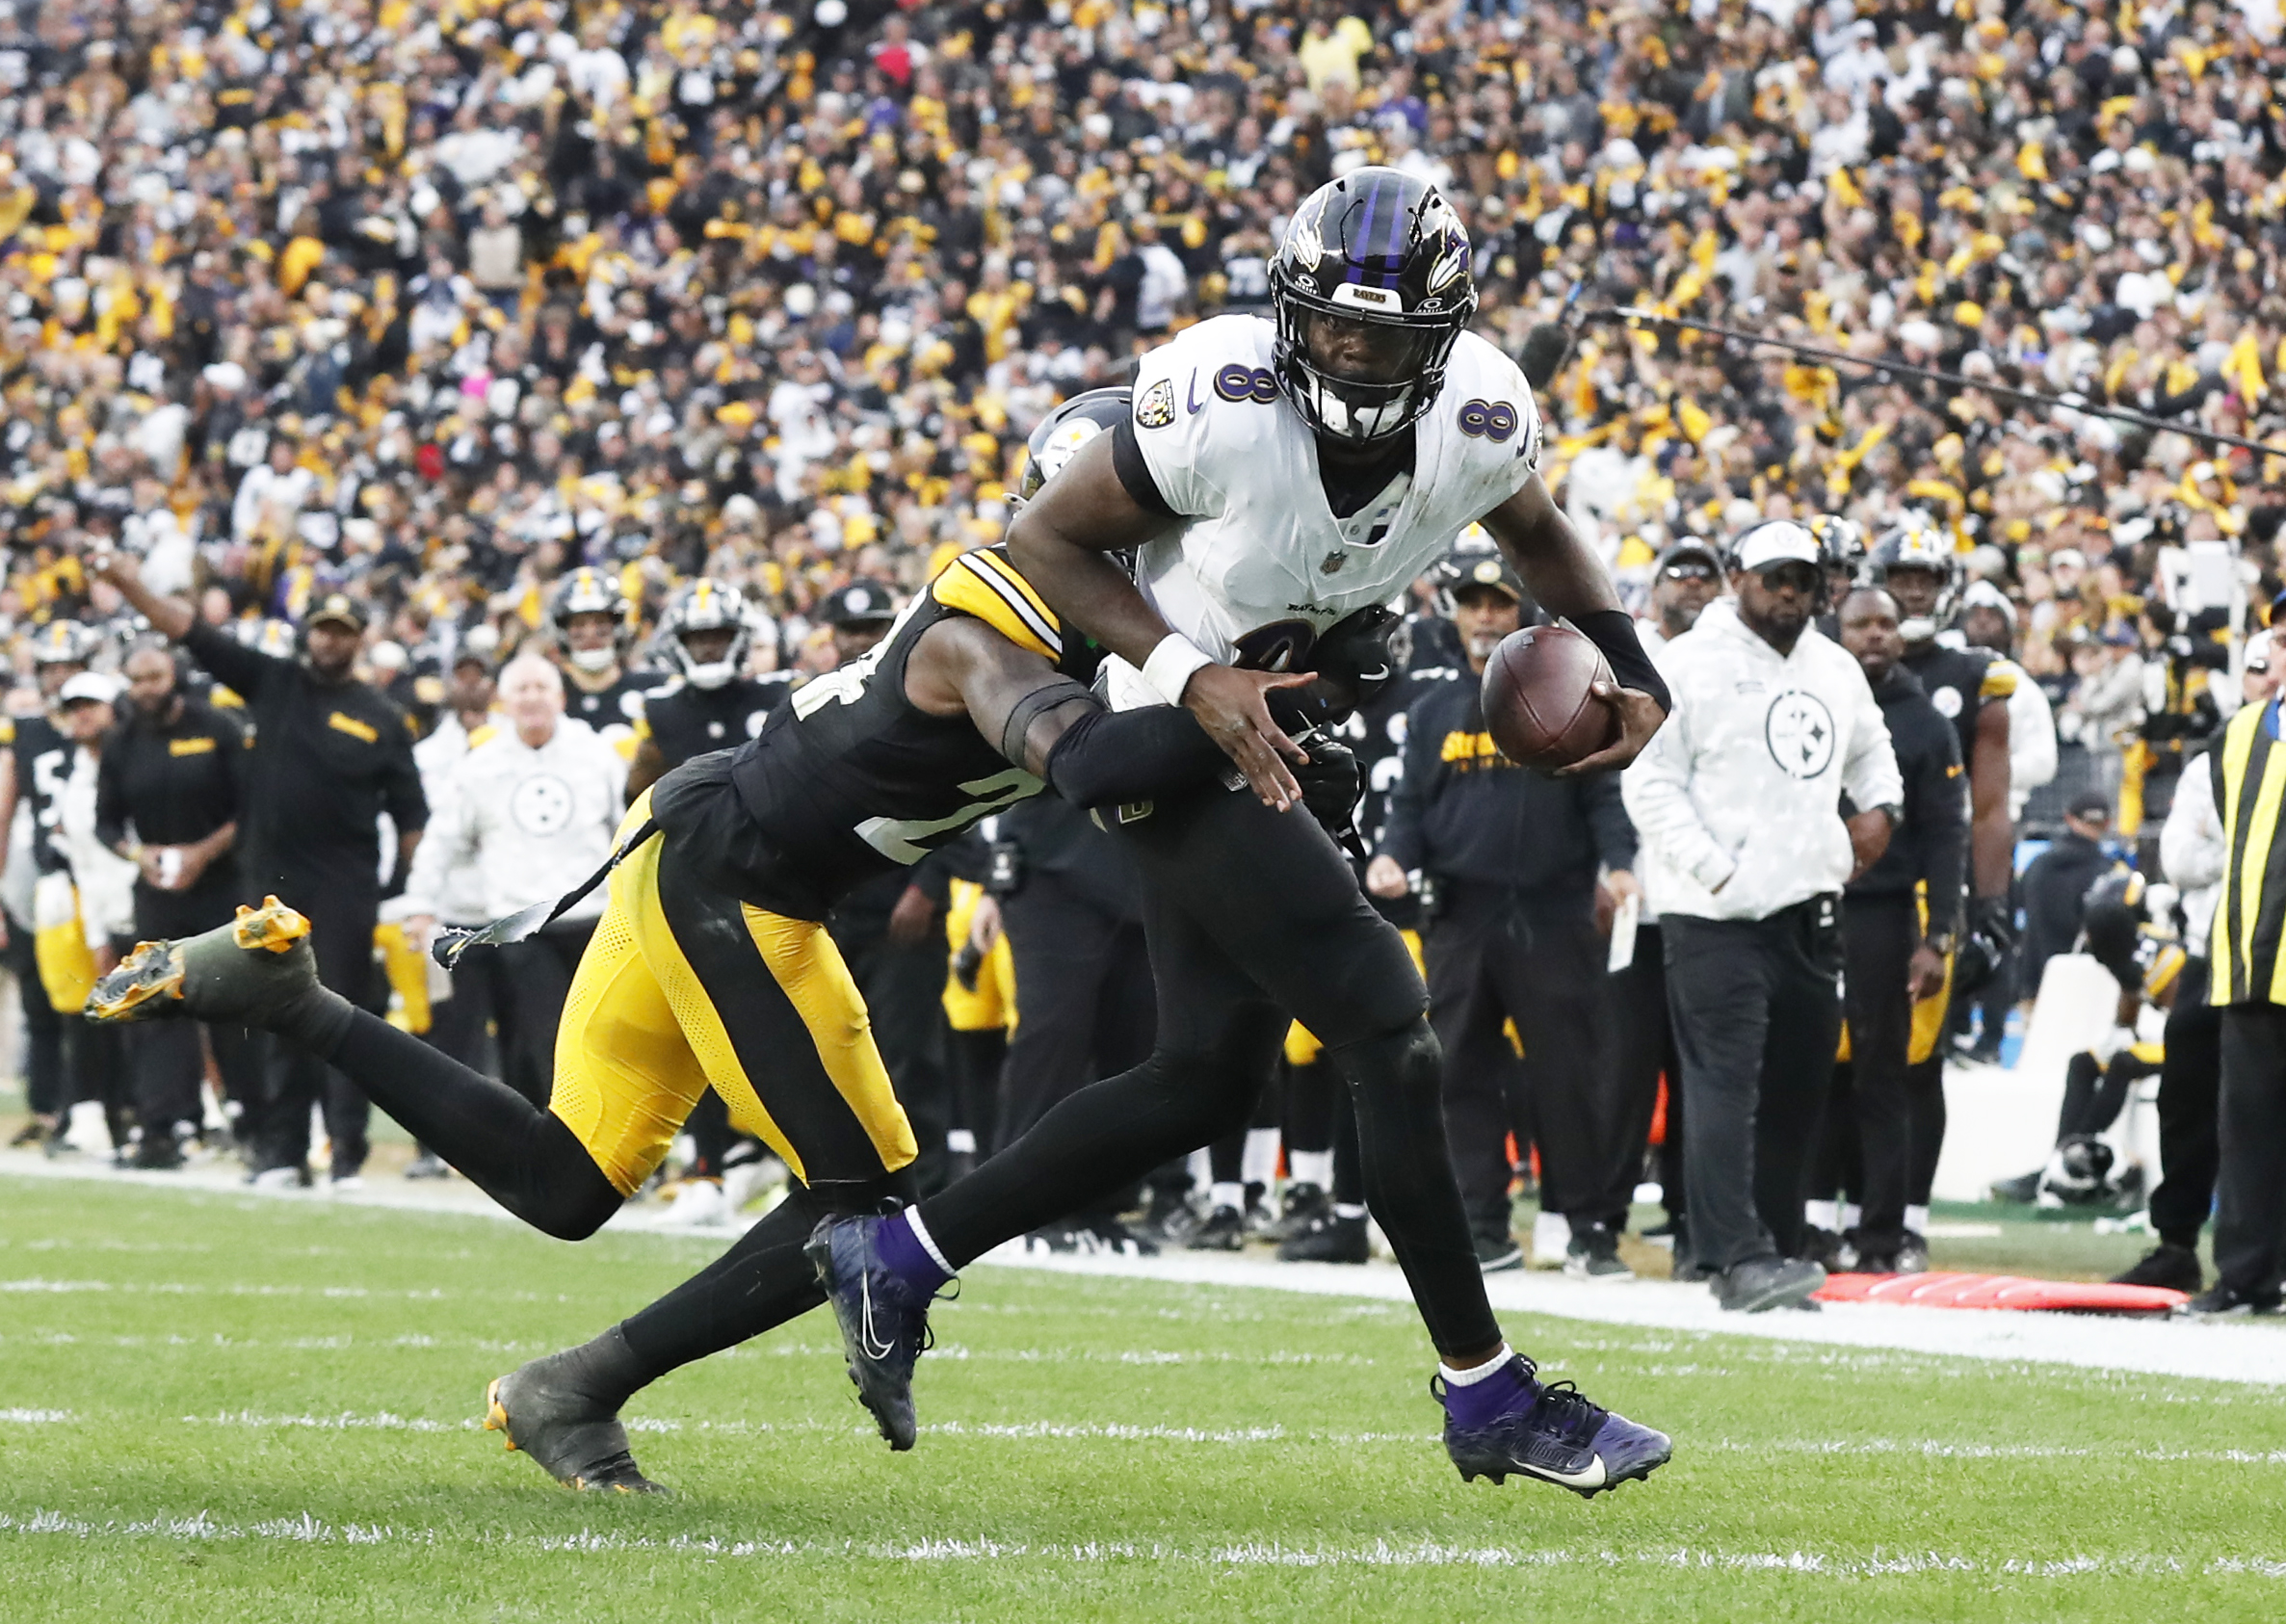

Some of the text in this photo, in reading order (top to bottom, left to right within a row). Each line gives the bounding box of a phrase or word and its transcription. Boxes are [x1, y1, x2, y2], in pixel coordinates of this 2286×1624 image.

[1353, 288, 1387, 303] RAVENS
[1214, 363, 1279, 405] 8
[1457, 398, 1518, 444] 8
